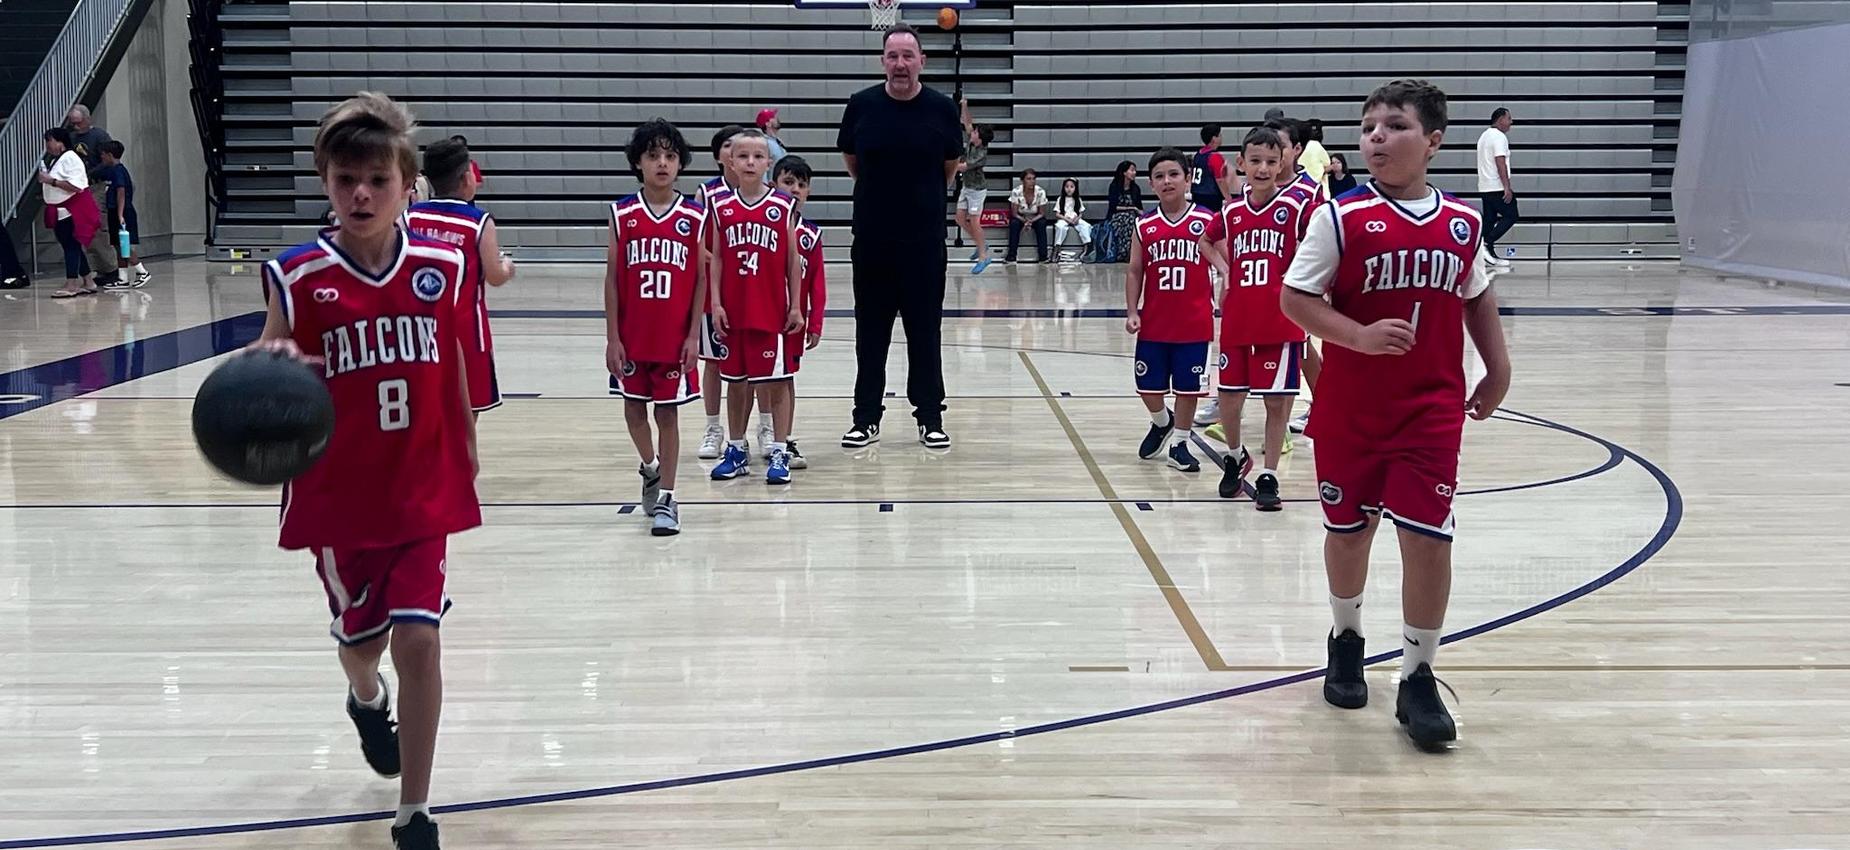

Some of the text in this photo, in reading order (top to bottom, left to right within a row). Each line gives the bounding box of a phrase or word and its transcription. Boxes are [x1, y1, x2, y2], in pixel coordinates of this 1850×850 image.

[1191, 167, 1203, 185] 13
[737, 250, 759, 276] 34
[1240, 259, 1269, 287] 30
[639, 270, 672, 299] 20
[1158, 266, 1186, 291] 20
[321, 315, 440, 379] FALCONS
[377, 378, 411, 431] 8
